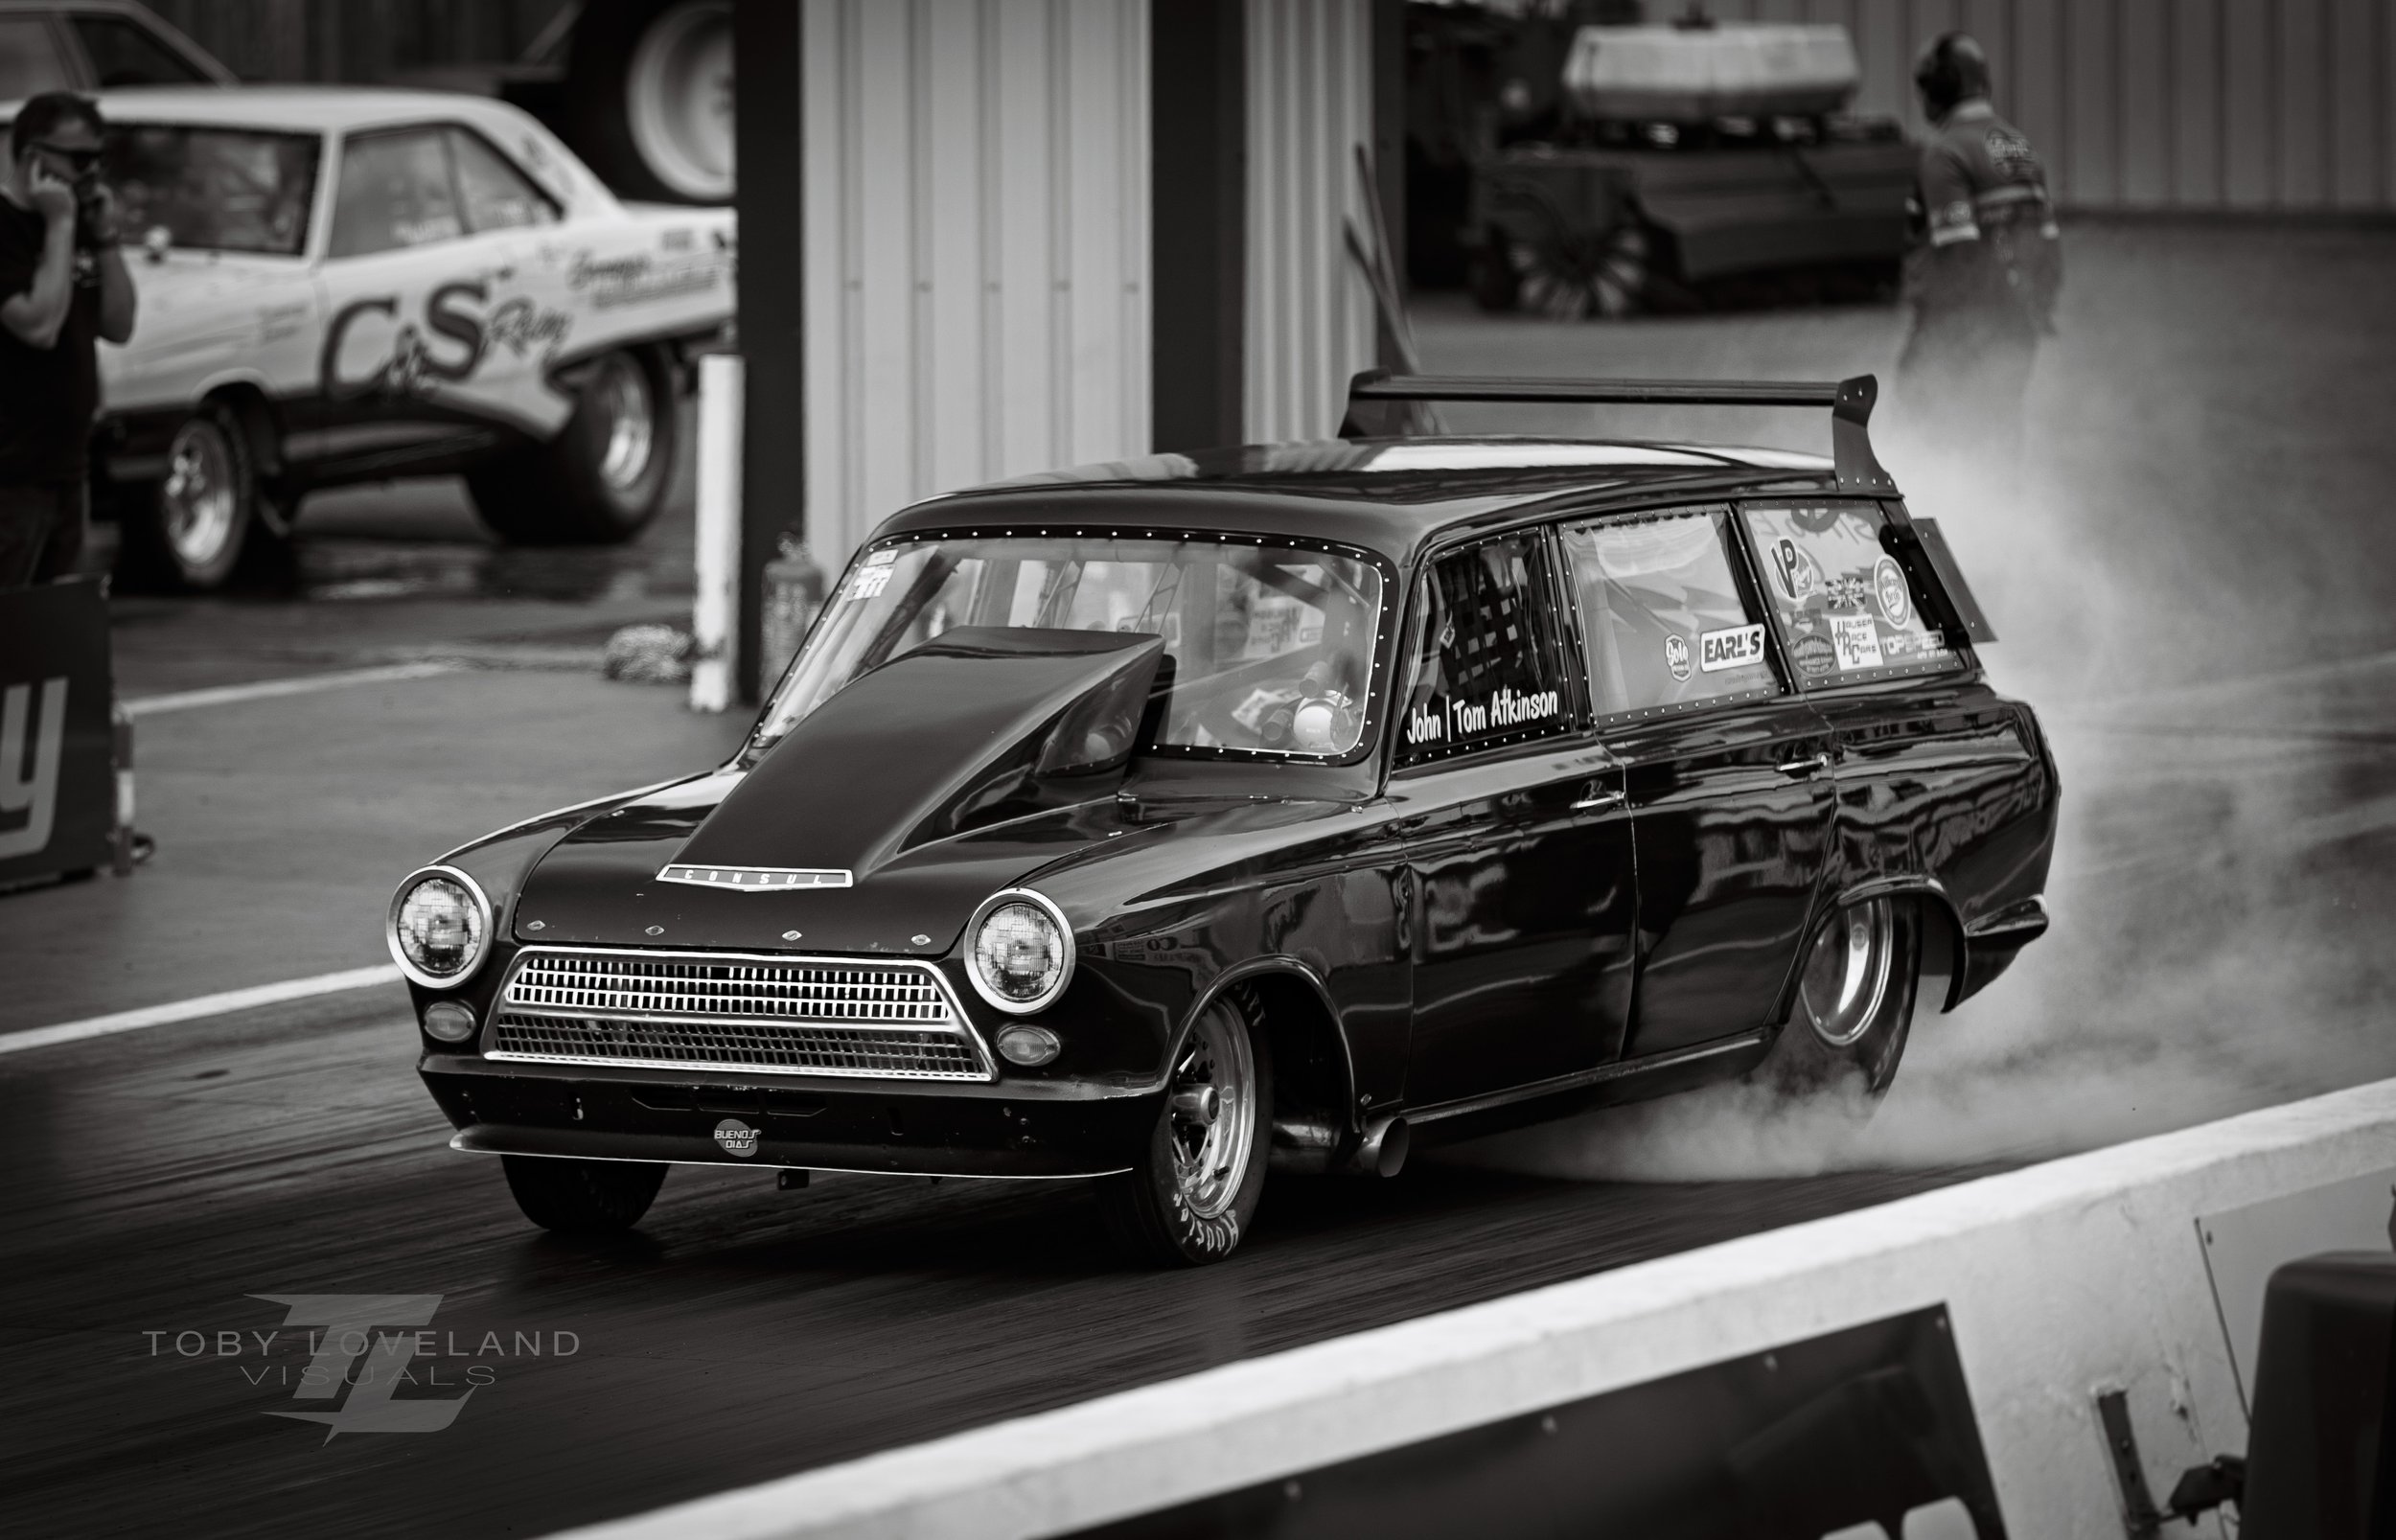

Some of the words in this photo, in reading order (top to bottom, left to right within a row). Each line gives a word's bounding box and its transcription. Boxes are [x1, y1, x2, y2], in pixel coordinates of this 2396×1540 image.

[1770, 539, 1799, 599] VP
[1705, 632, 1762, 664] EARL'S
[1407, 702, 1441, 745] John
[1452, 699, 1486, 734] Tom
[1490, 686, 1558, 727] Atkinson
[683, 869, 822, 885] CONSUL
[714, 1129, 762, 1139] BUENOS
[726, 1139, 753, 1149] DIAS
